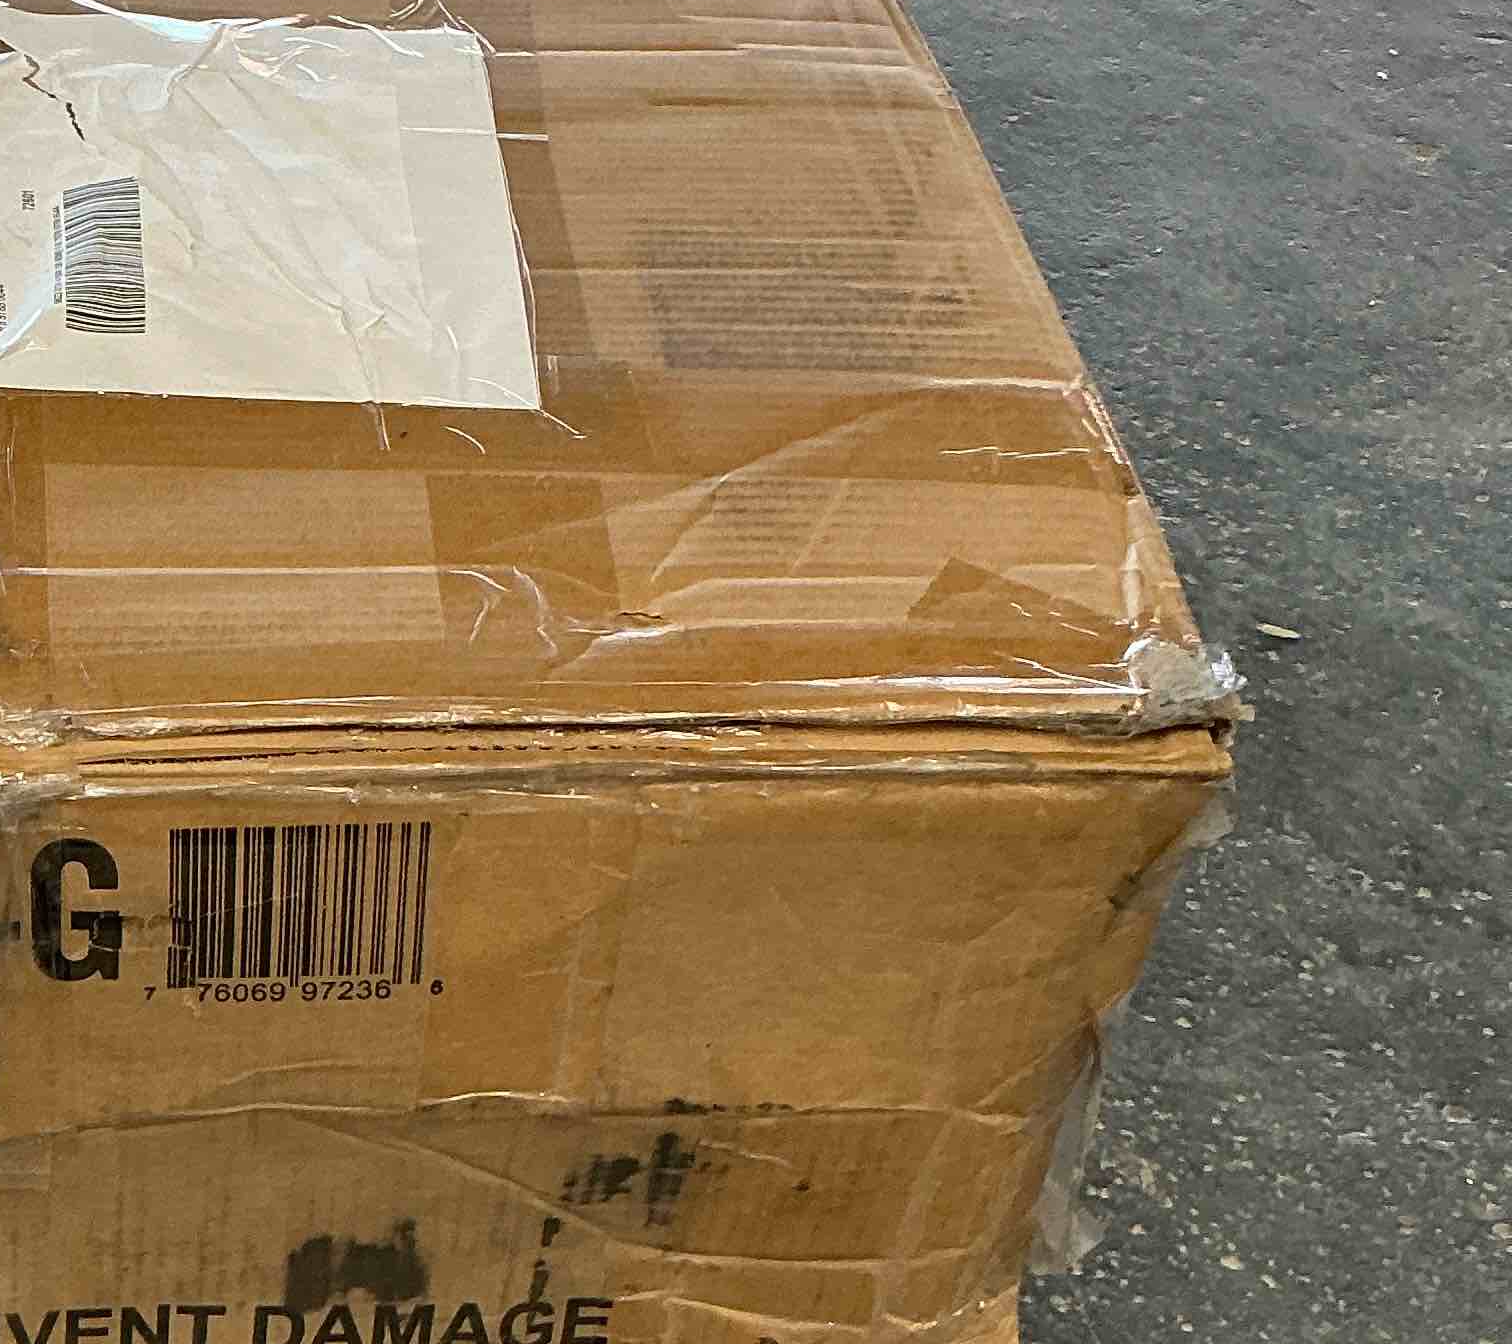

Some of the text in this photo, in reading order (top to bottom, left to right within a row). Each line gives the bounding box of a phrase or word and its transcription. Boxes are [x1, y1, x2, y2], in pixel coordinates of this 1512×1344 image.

[143, 985, 156, 1000] 7
[196, 982, 286, 1002] 76069
[301, 979, 392, 1002] 97236
